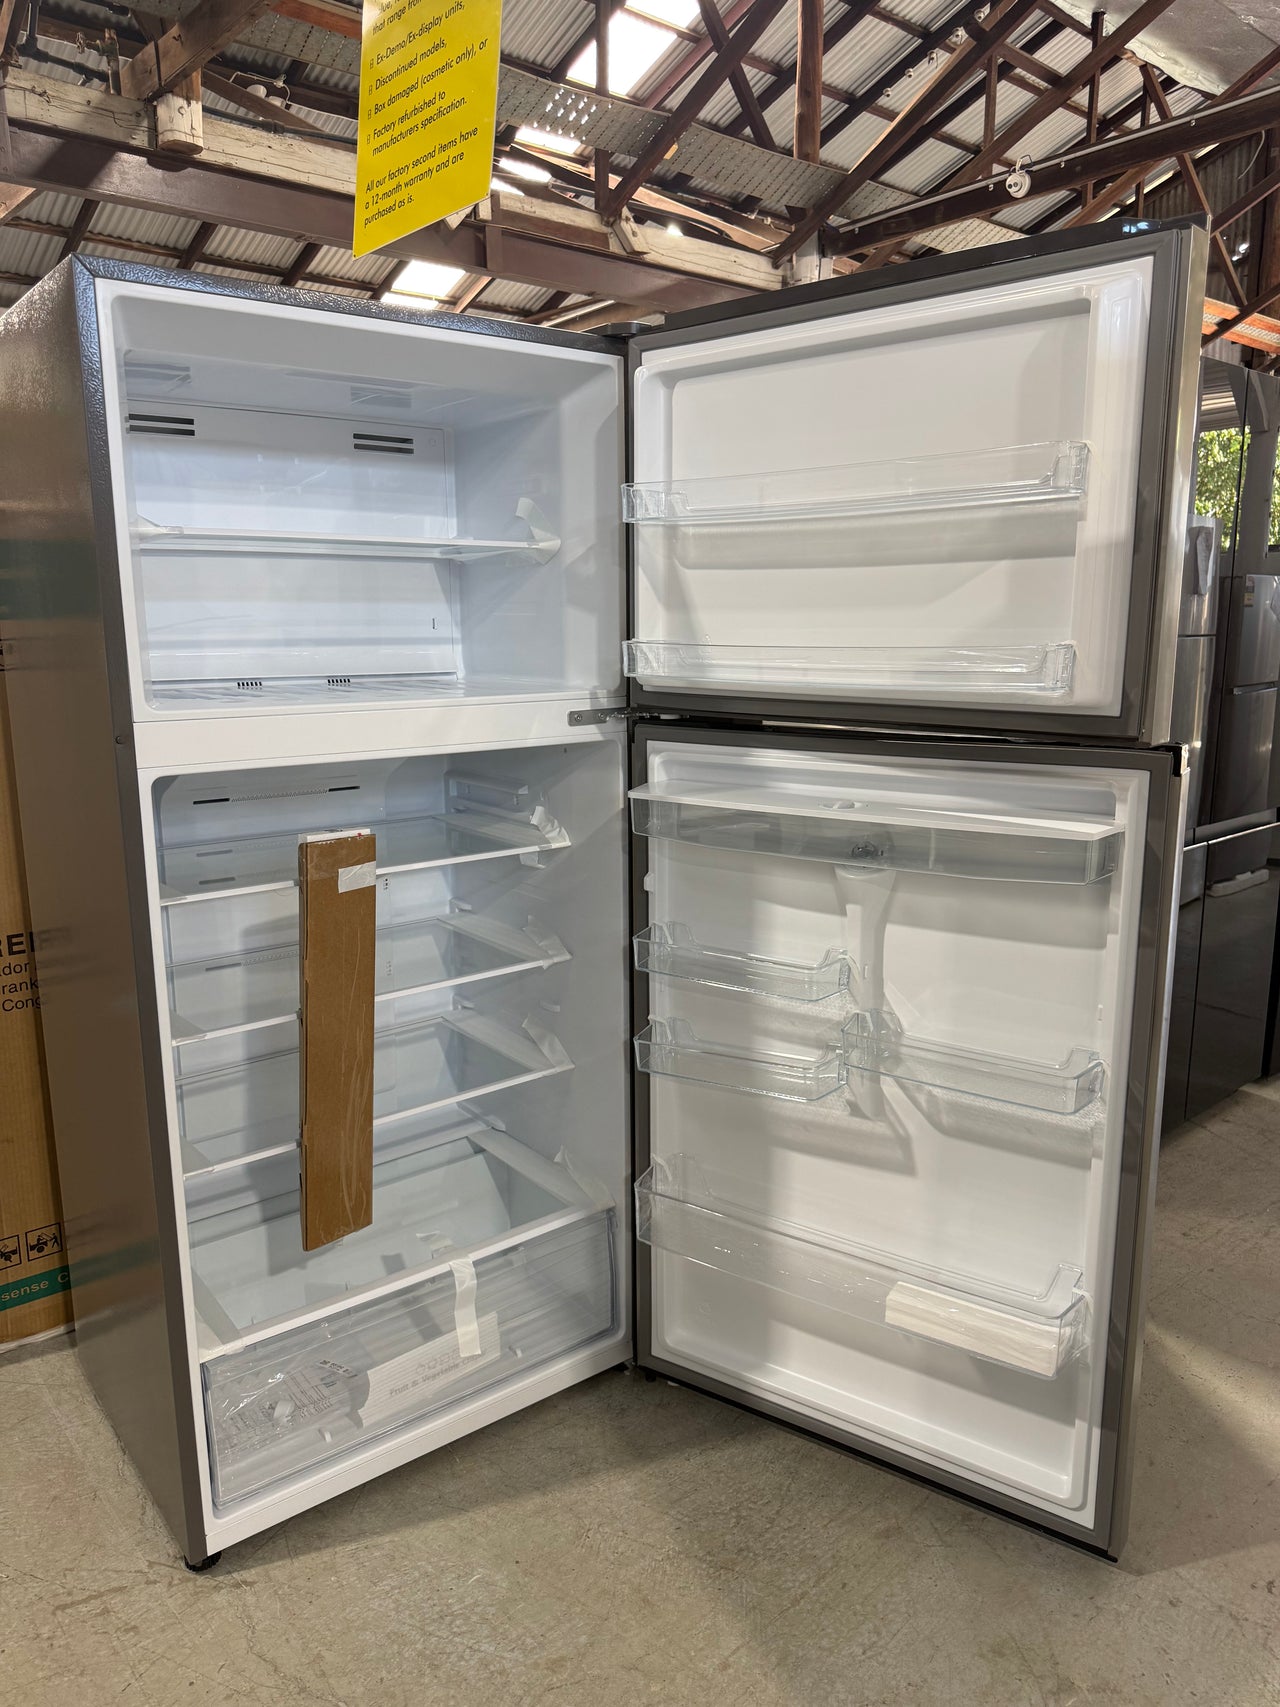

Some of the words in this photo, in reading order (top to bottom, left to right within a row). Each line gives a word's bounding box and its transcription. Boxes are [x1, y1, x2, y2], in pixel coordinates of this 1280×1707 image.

[376, 14, 443, 65] Ex-Demo/Ex-display
[444, 1, 465, 20] units,
[387, 6, 406, 25] range
[374, 102, 386, 115] Box
[387, 77, 419, 107] damaged
[420, 59, 454, 88] (cosmetic
[456, 43, 477, 65] only),
[479, 38, 489, 51] or
[375, 53, 418, 91] Discontinued
[419, 37, 447, 61] models,
[372, 122, 419, 156] manufacturers
[420, 97, 468, 130] specification.
[373, 120, 396, 140] Factory
[398, 96, 437, 125] refurbished
[438, 90, 446, 103] to
[364, 202, 370, 210] a
[371, 180, 402, 207] 12-month
[404, 167, 434, 189] warranty
[436, 157, 450, 172] and
[452, 151, 464, 164] are
[365, 179, 374, 194] All
[376, 176, 387, 188] our
[388, 163, 411, 183] factory
[412, 145, 436, 169] second
[437, 140, 457, 155] items
[459, 126, 478, 144] have
[364, 201, 400, 228] purchased
[398, 197, 405, 208] as
[407, 193, 415, 205] is.
[0, 962, 30, 976] dor
[390, 1383, 409, 1396] Fruit
